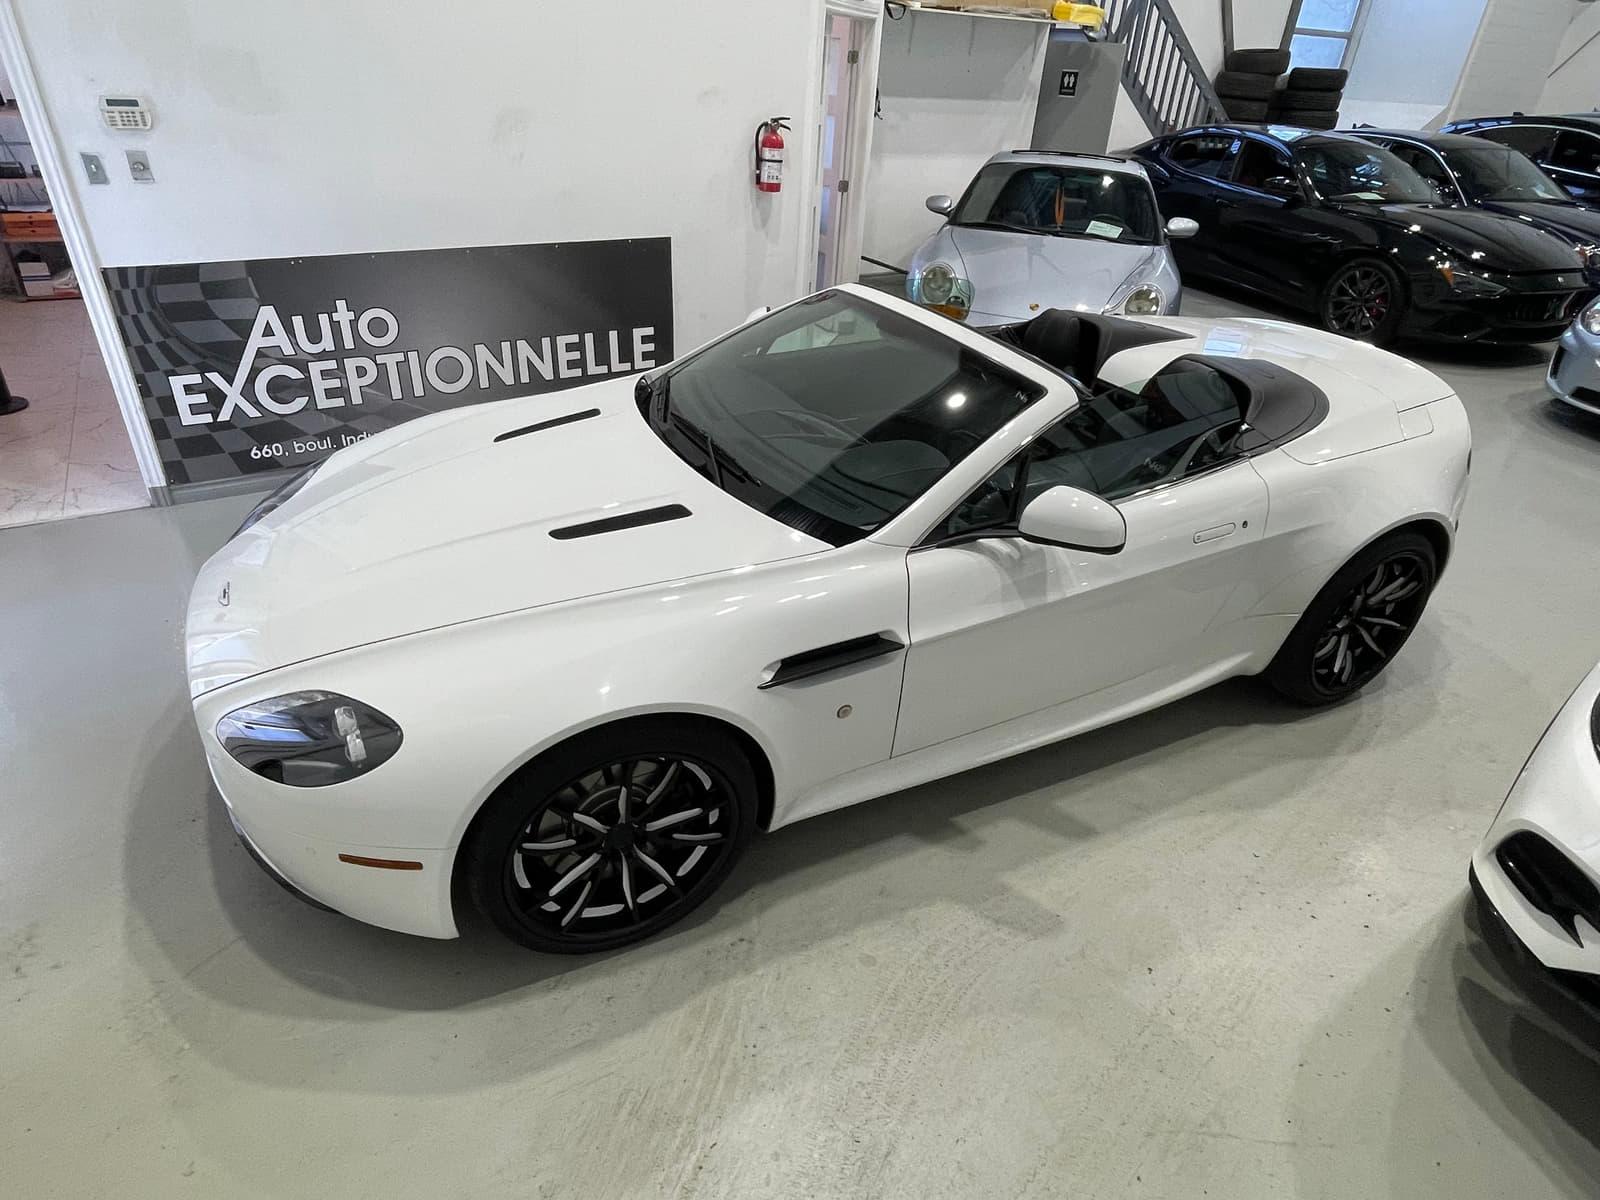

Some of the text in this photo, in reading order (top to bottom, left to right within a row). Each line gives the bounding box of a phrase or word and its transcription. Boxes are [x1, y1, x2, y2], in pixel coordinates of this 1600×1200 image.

[241, 299, 399, 357] Auto
[168, 326, 656, 426] EXCEPTIONNELLE
[250, 431, 371, 459] 660, boul. Ind
